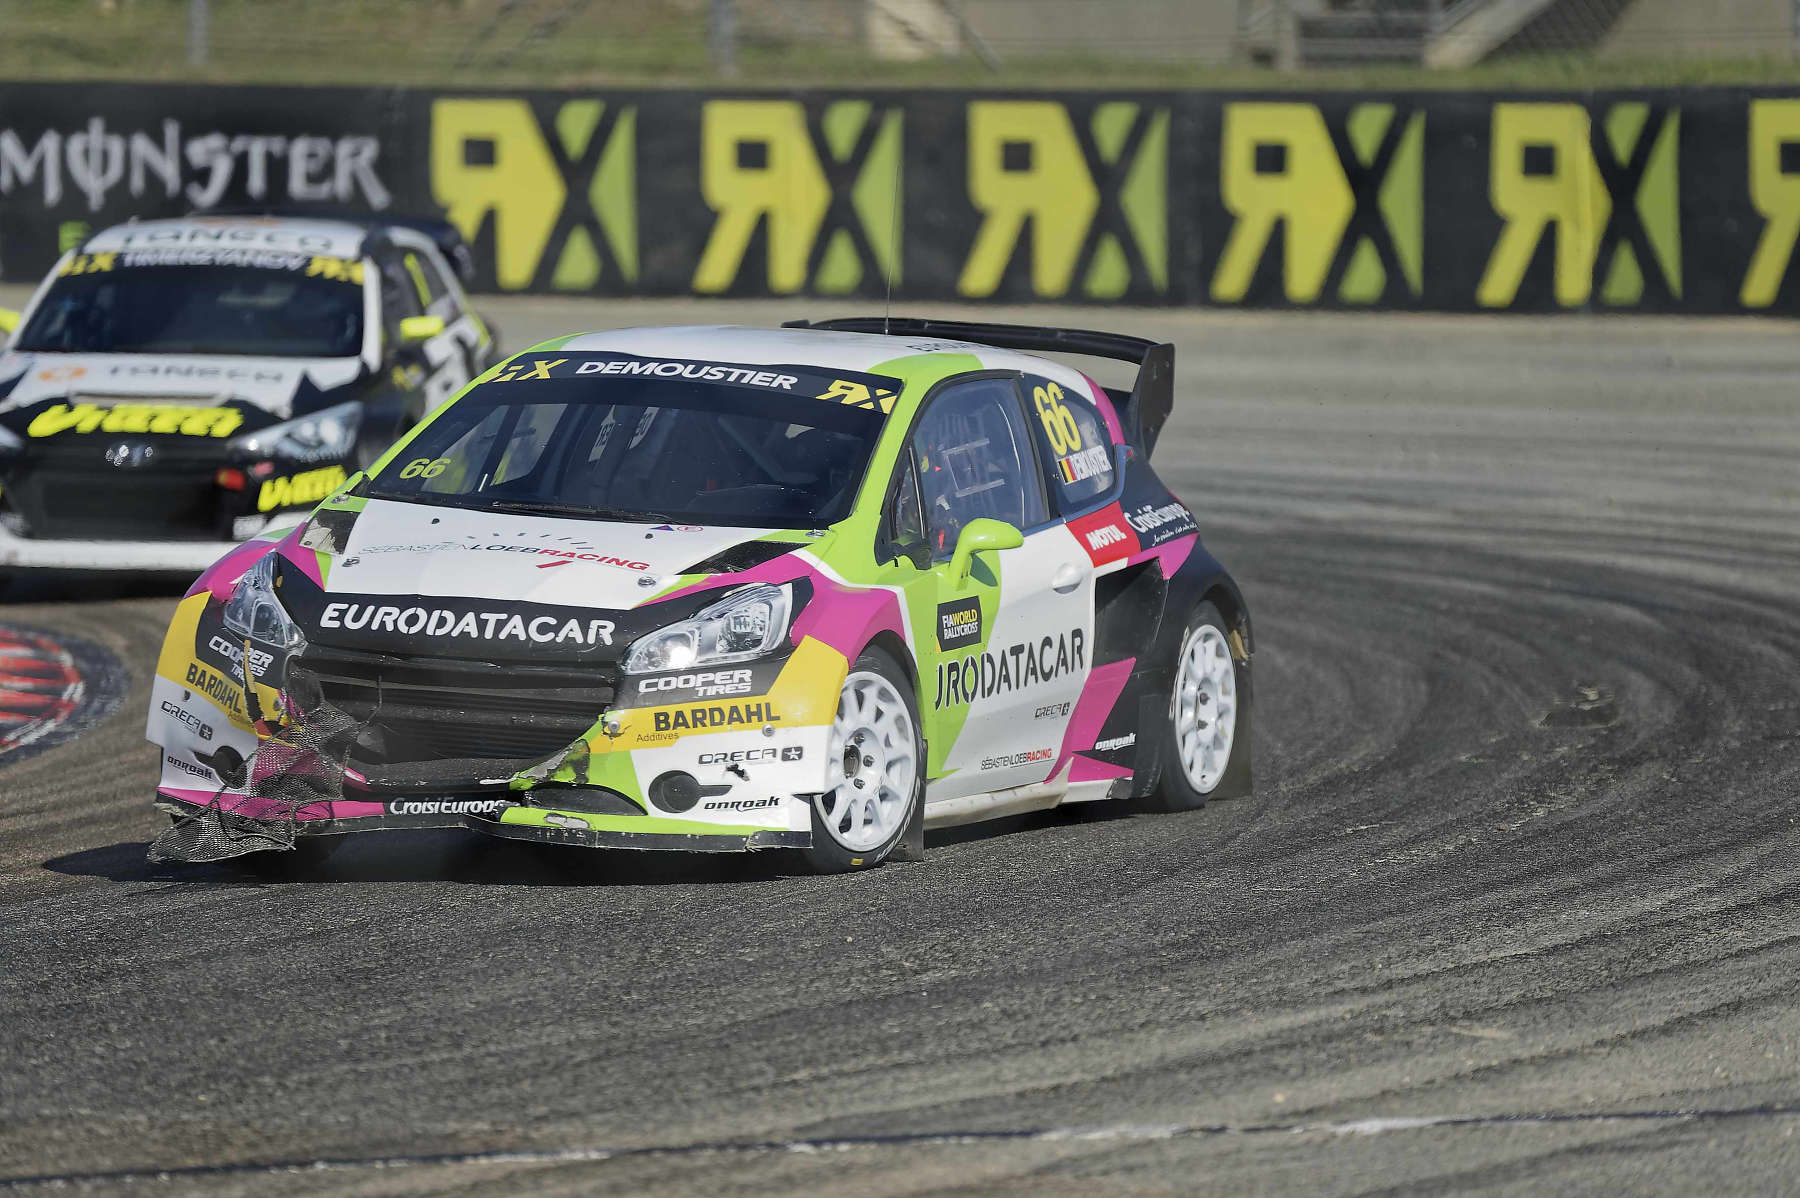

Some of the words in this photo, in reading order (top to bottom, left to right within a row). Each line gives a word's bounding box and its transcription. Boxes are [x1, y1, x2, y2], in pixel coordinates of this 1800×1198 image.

[0, 117, 390, 211] MONSTER
[692, 100, 903, 294] RX
[957, 102, 1170, 298] RX
[1210, 102, 1426, 301] RX
[1476, 102, 1682, 307] RX
[575, 361, 798, 391] DEMOUSTIER
[815, 379, 897, 415] RX
[1033, 382, 1082, 456] 66
[400, 458, 451, 479] 66
[1085, 524, 1127, 551] MOTUL
[320, 602, 616, 646] EURODATACAR
[943, 621, 979, 640] RALLYCROSS
[185, 662, 242, 714] BARDAHL
[638, 669, 752, 694] COOPER
[694, 682, 752, 698] TIRES
[161, 700, 201, 731] ORECA
[654, 702, 781, 732] BARDAHL
[636, 731, 680, 743] Additives
[167, 755, 213, 780] onroak
[698, 747, 777, 765] ORECA
[703, 796, 781, 812] onroak
